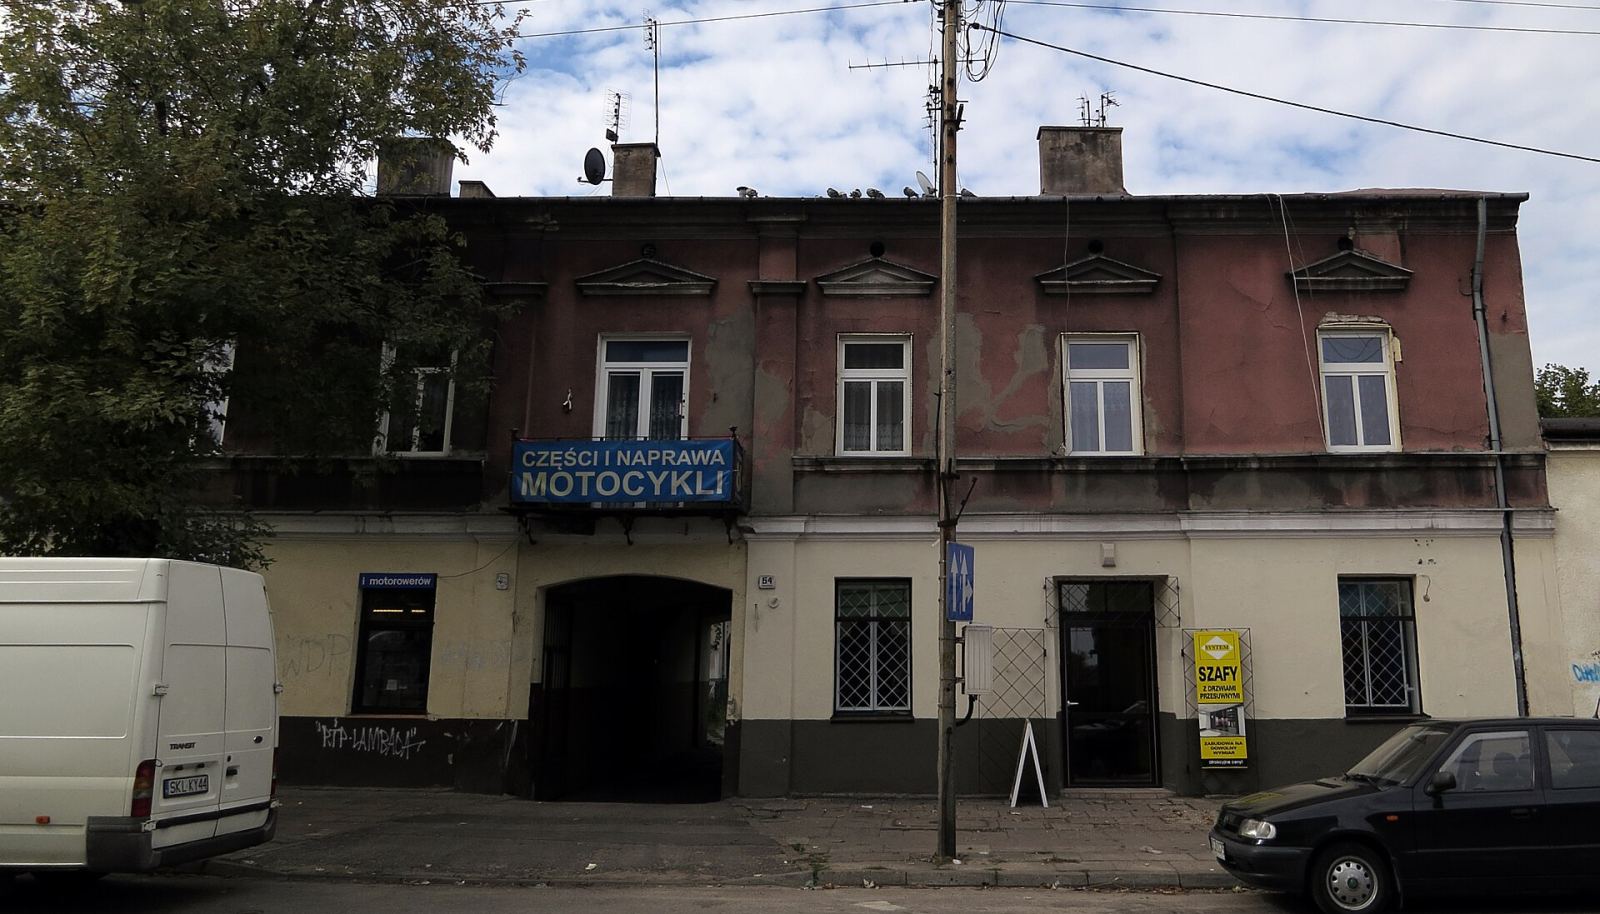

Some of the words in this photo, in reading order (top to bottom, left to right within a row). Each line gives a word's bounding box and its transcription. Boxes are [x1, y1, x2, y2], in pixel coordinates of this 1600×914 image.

[522, 447, 598, 470] CZĘŚCI
[604, 450, 610, 466] I
[616, 449, 725, 466] NAPRAWA
[520, 470, 724, 497] MOTOCYKLI
[369, 576, 432, 586] motorowerów
[1198, 666, 1238, 682] SZAFY
[169, 742, 196, 750] TRANSIT
[169, 779, 187, 794] SKL
[188, 776, 207, 792] KY44
